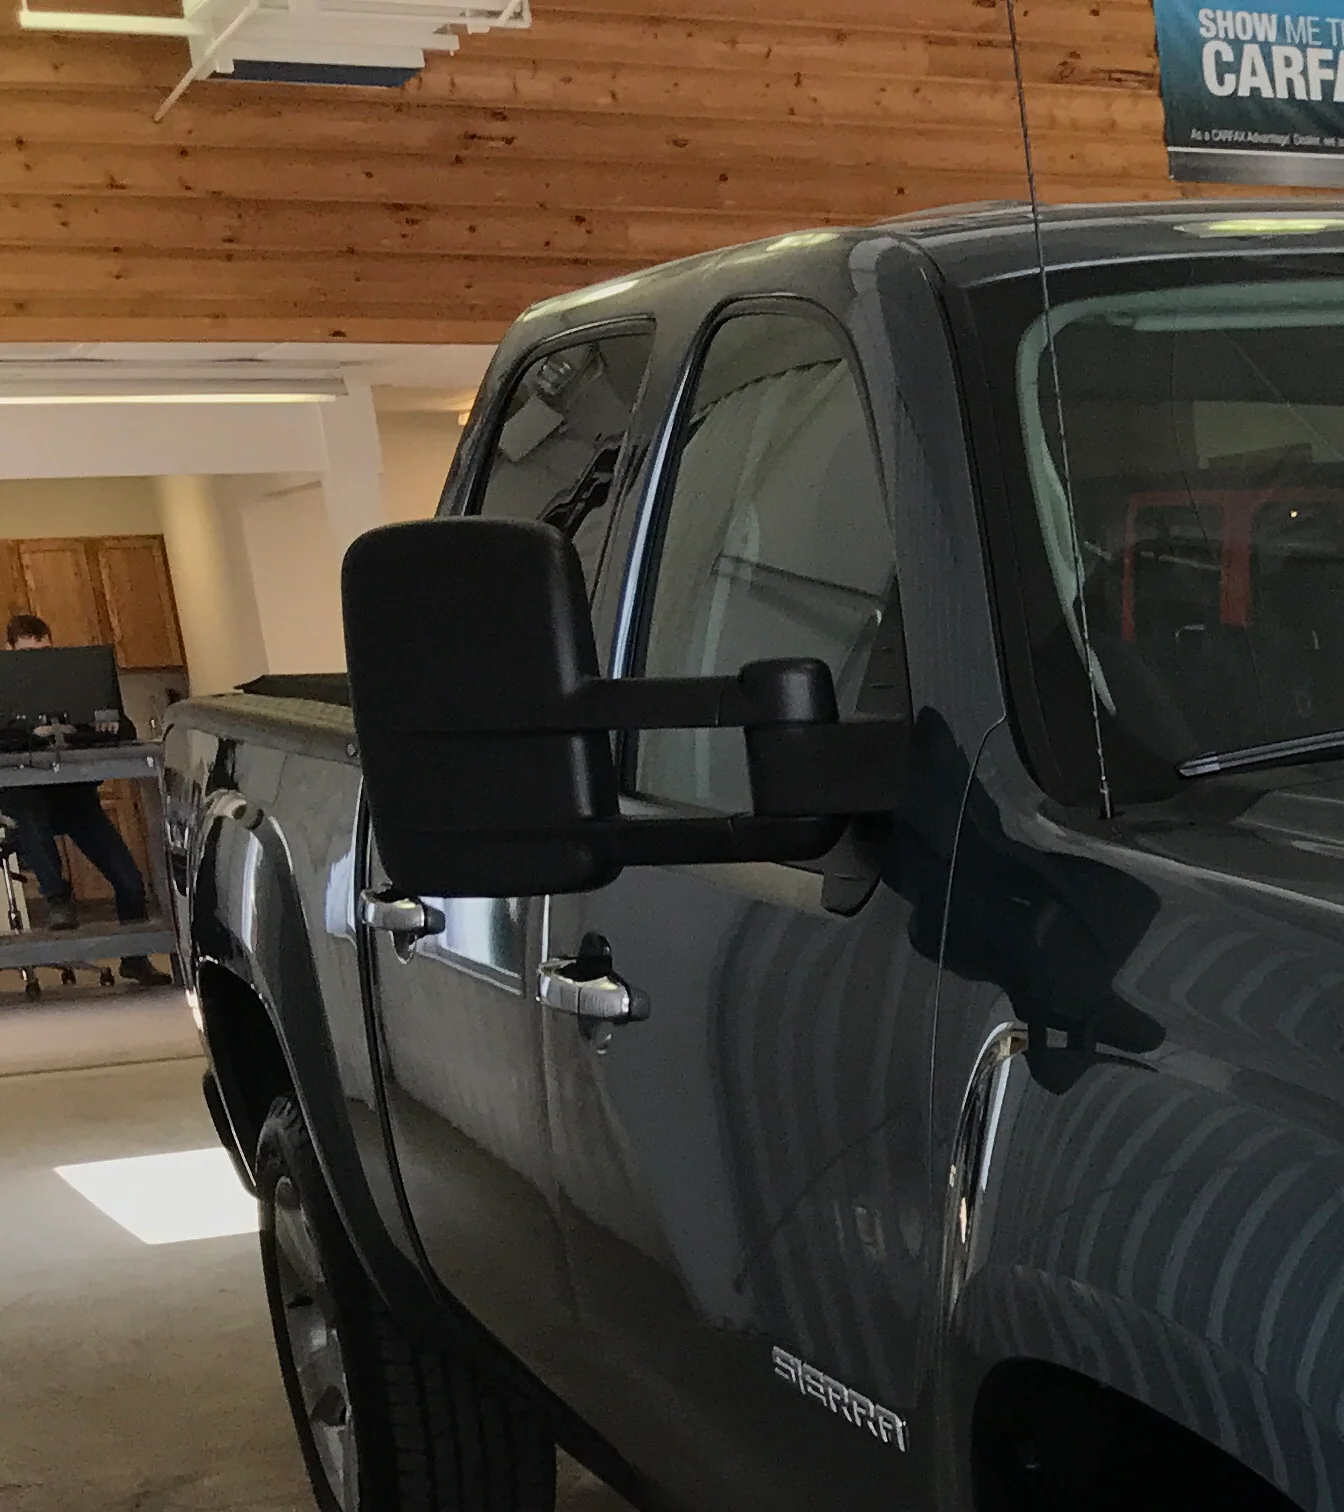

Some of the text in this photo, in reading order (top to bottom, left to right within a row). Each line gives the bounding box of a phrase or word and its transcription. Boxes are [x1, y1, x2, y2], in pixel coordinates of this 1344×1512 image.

[1198, 8, 1278, 43] SHOW
[1284, 15, 1322, 46] ME
[771, 1345, 908, 1453] SIERRA
